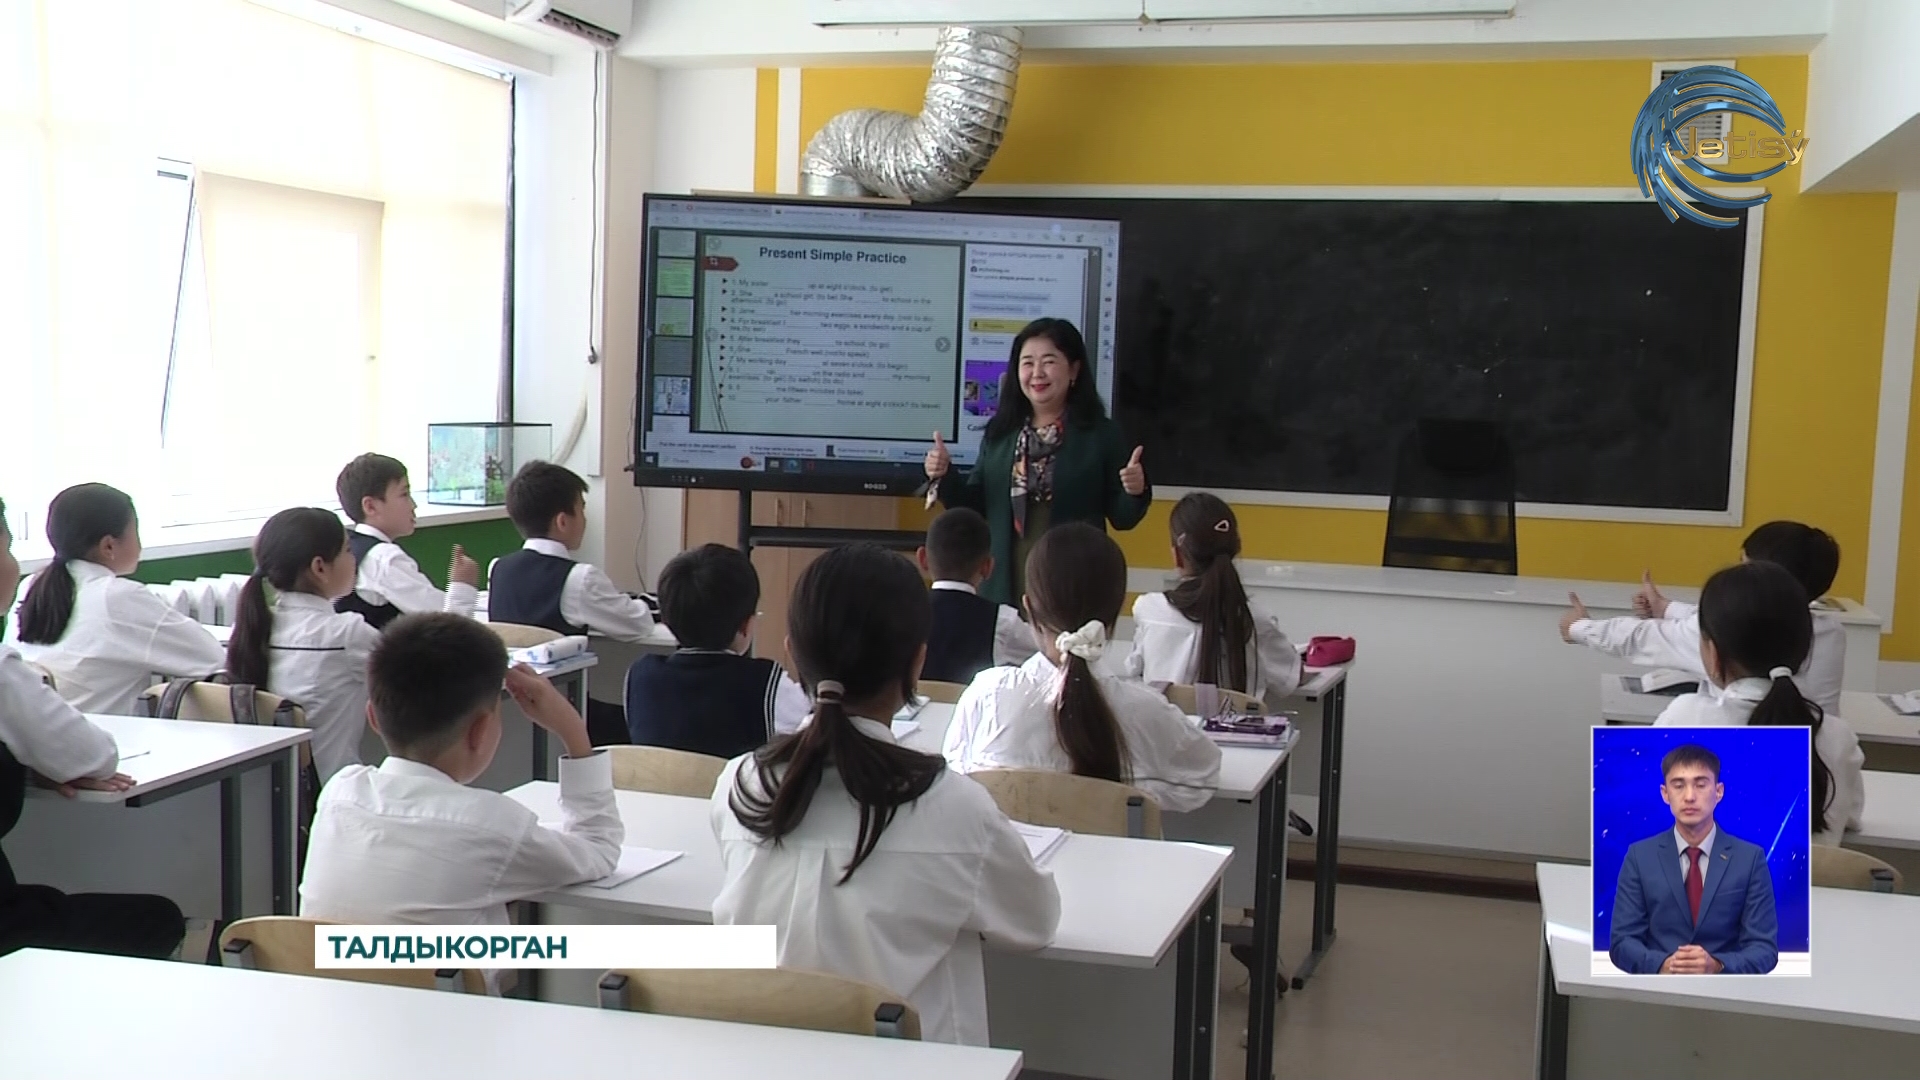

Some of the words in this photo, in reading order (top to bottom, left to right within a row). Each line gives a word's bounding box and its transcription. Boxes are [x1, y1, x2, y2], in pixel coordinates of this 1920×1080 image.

[759, 246, 807, 260] Present
[810, 248, 853, 263] Simple
[856, 251, 907, 264] Practice
